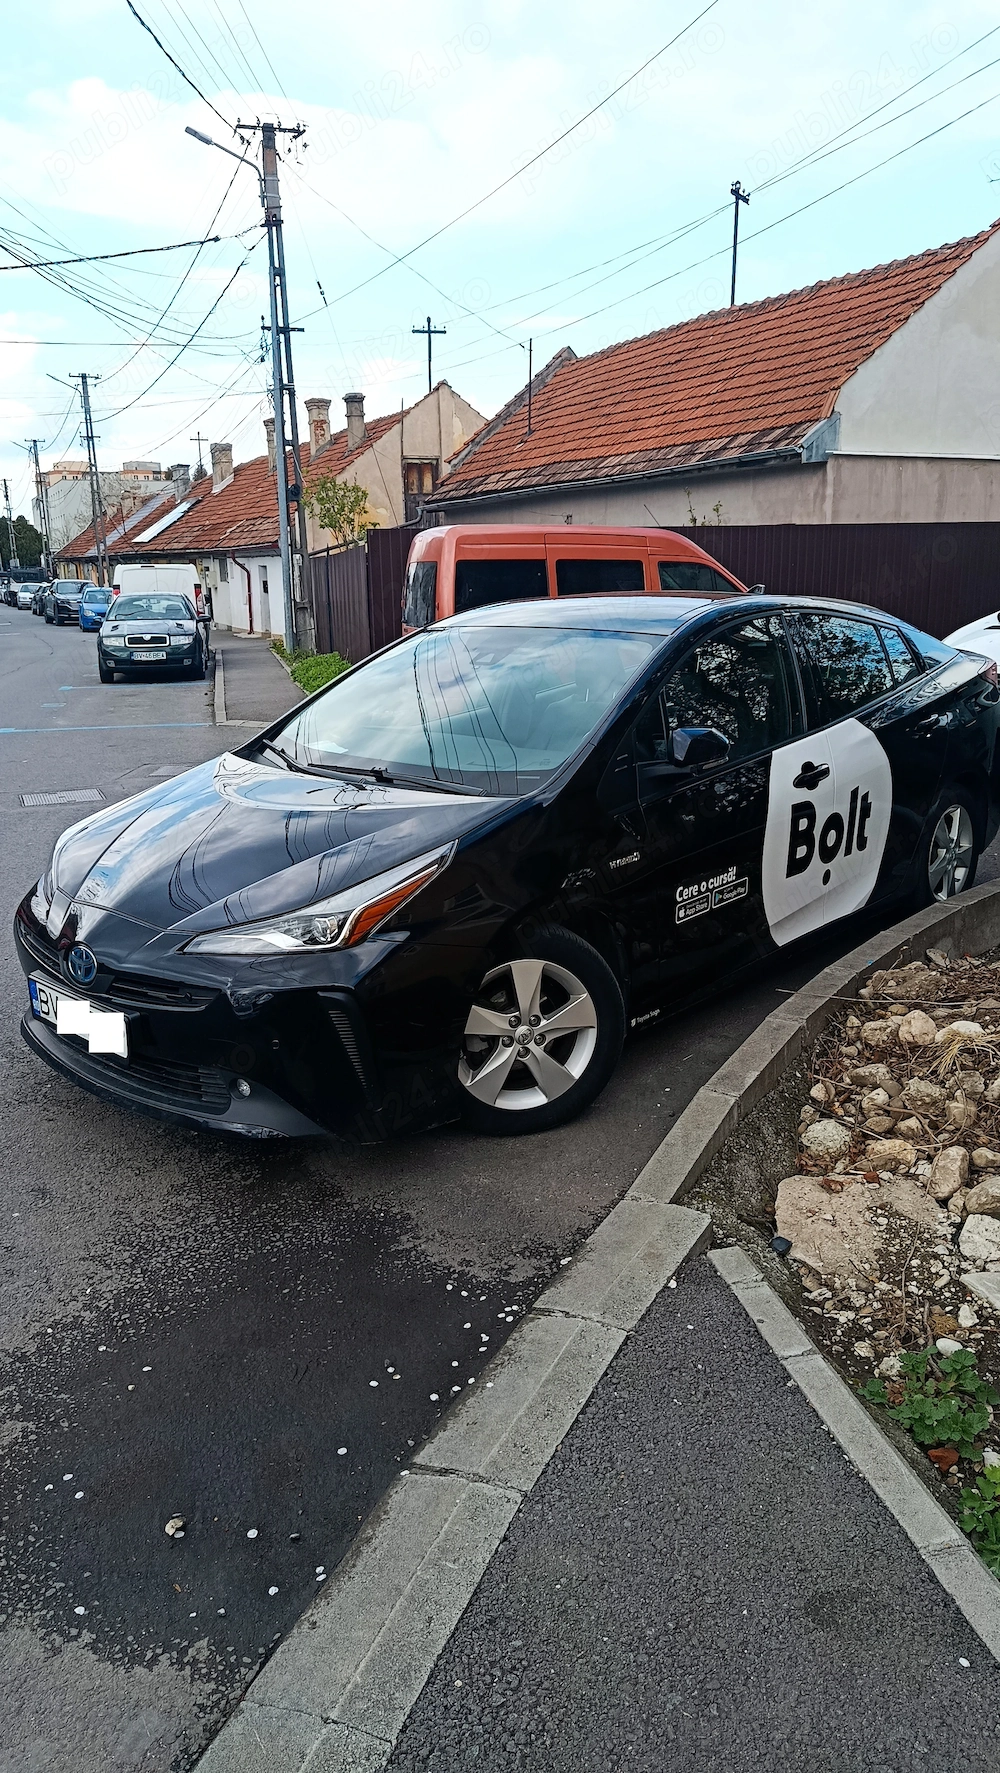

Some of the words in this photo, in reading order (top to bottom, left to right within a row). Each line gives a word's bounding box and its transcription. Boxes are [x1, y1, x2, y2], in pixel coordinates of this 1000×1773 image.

[785, 785, 873, 879] Bolt
[676, 885, 699, 902] Cere
[700, 881, 707, 892] o
[708, 866, 737, 889] cursă!
